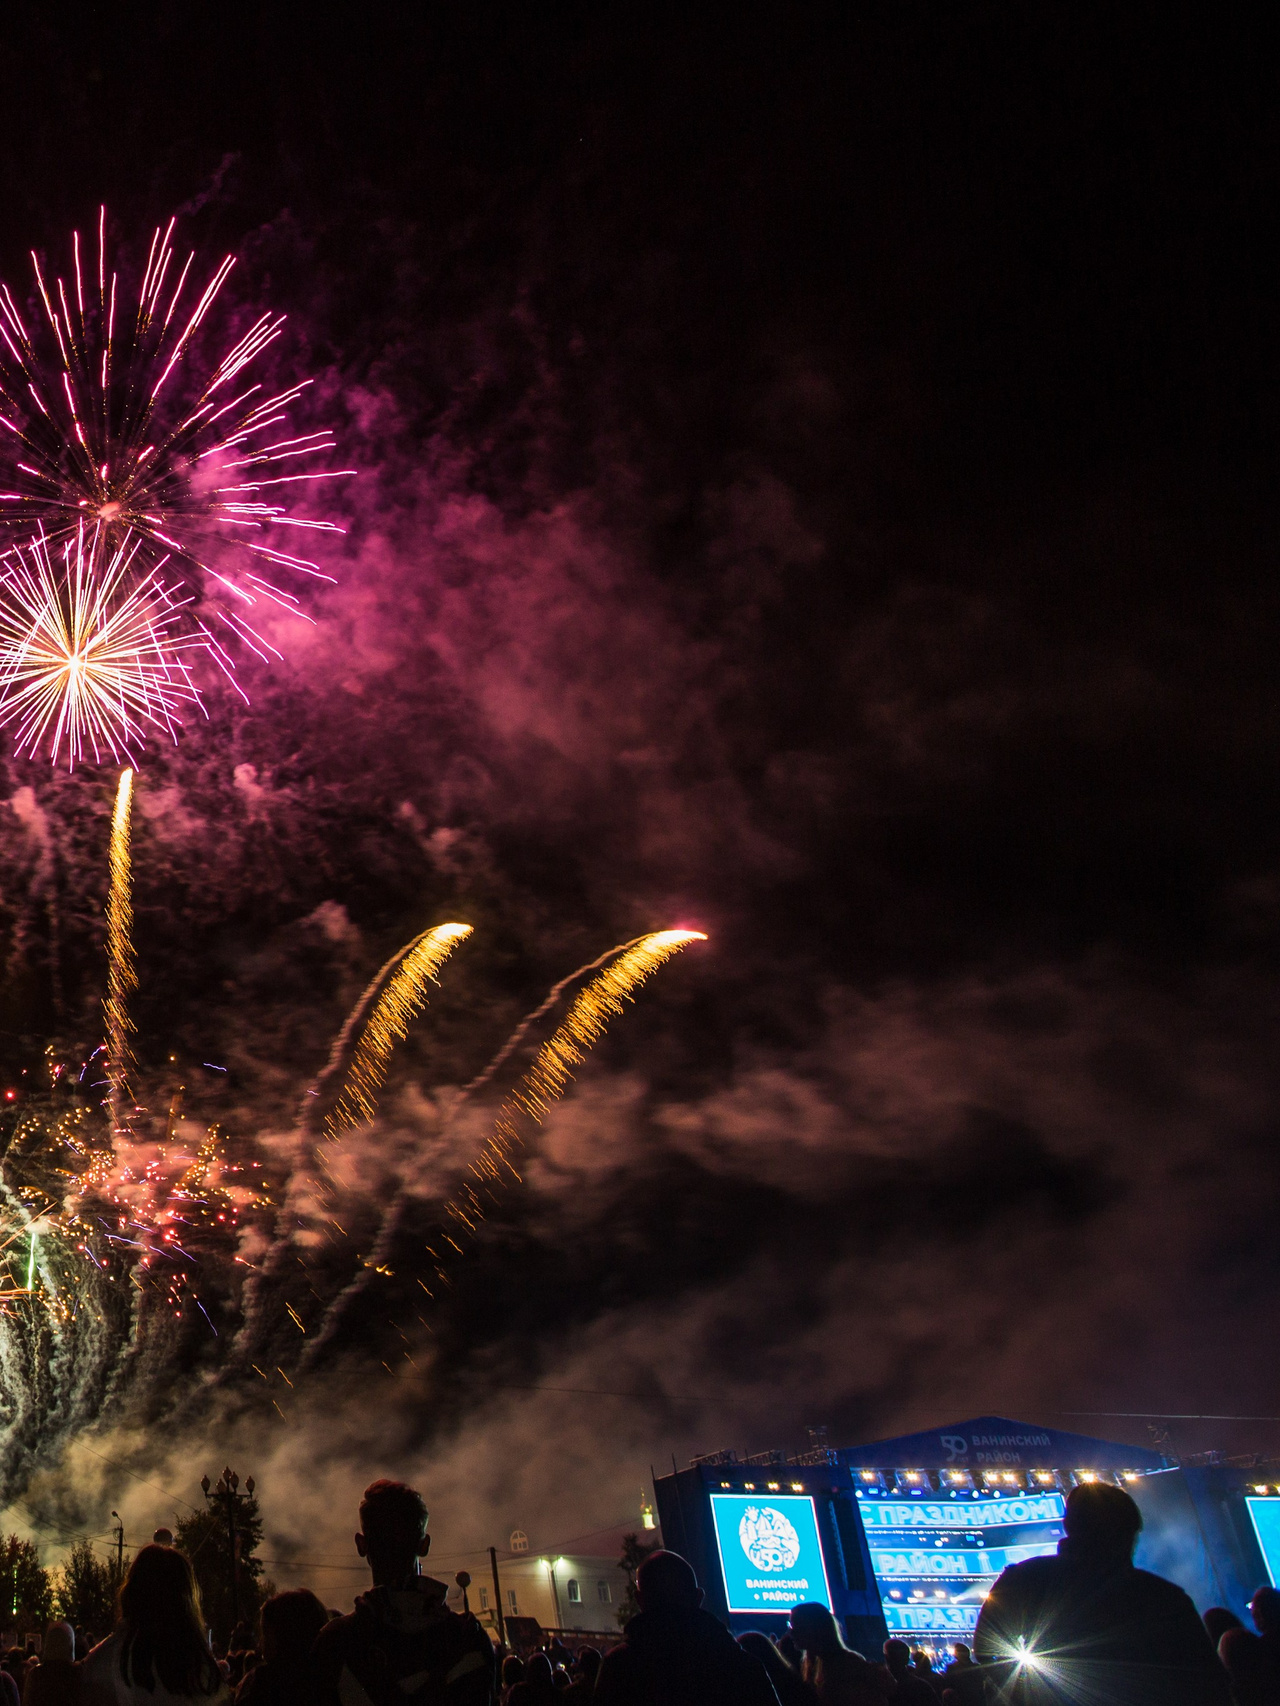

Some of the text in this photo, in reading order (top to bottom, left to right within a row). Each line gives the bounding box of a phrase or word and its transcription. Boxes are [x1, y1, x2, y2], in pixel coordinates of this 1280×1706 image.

[971, 1434, 1051, 1446] ВАНИНСКИЙ
[976, 1450, 1021, 1463] РАЙОН
[877, 1497, 1061, 1526] ПРАЗДНИКОМ!
[877, 1550, 970, 1574] РАЙОН
[746, 1578, 809, 1589] ВАНИНСКИЙ
[762, 1590, 797, 1602] РАЙОН
[897, 1608, 981, 1629] ПРАЗД
